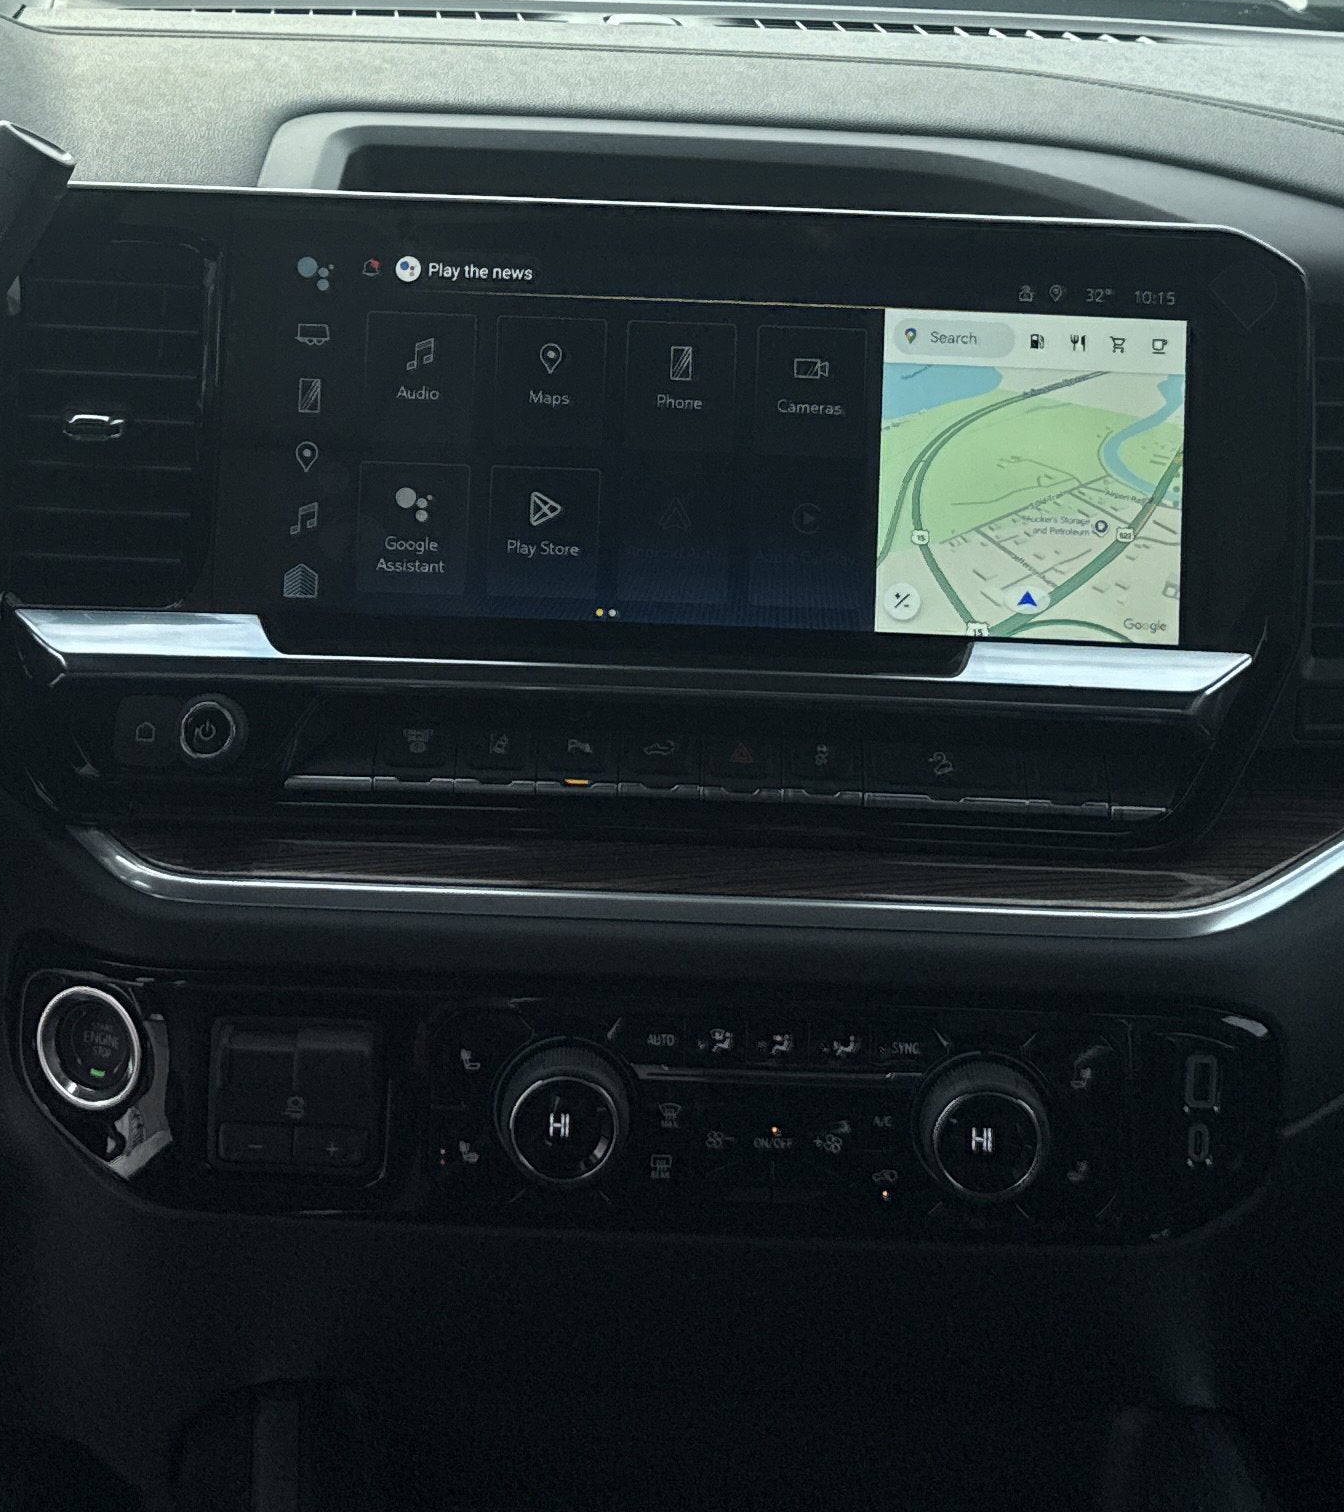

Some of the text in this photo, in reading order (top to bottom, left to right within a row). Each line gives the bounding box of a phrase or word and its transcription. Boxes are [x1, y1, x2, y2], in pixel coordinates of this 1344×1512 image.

[428, 262, 533, 281] Play the news
[1134, 290, 1176, 306] 10:15
[930, 331, 978, 345] Search
[396, 386, 440, 400] Audio
[529, 390, 570, 407] Maps
[656, 394, 703, 410] Phone
[777, 399, 842, 416] Cameras
[1060, 516, 1090, 526] Storage
[1050, 527, 1090, 536] Petroleum
[384, 535, 439, 555] Google
[507, 539, 580, 558] Play Store
[375, 558, 446, 574] Assistant
[1123, 618, 1167, 634] Google
[84, 1030, 119, 1049] ENGINE
[647, 1033, 675, 1047] AUTO
[92, 1045, 112, 1058] STOP
[891, 1042, 920, 1055] SYNC
[549, 1113, 570, 1138] HI
[873, 1116, 892, 1128] A/C
[753, 1137, 793, 1150] ON/OFF
[971, 1127, 994, 1153] HI
